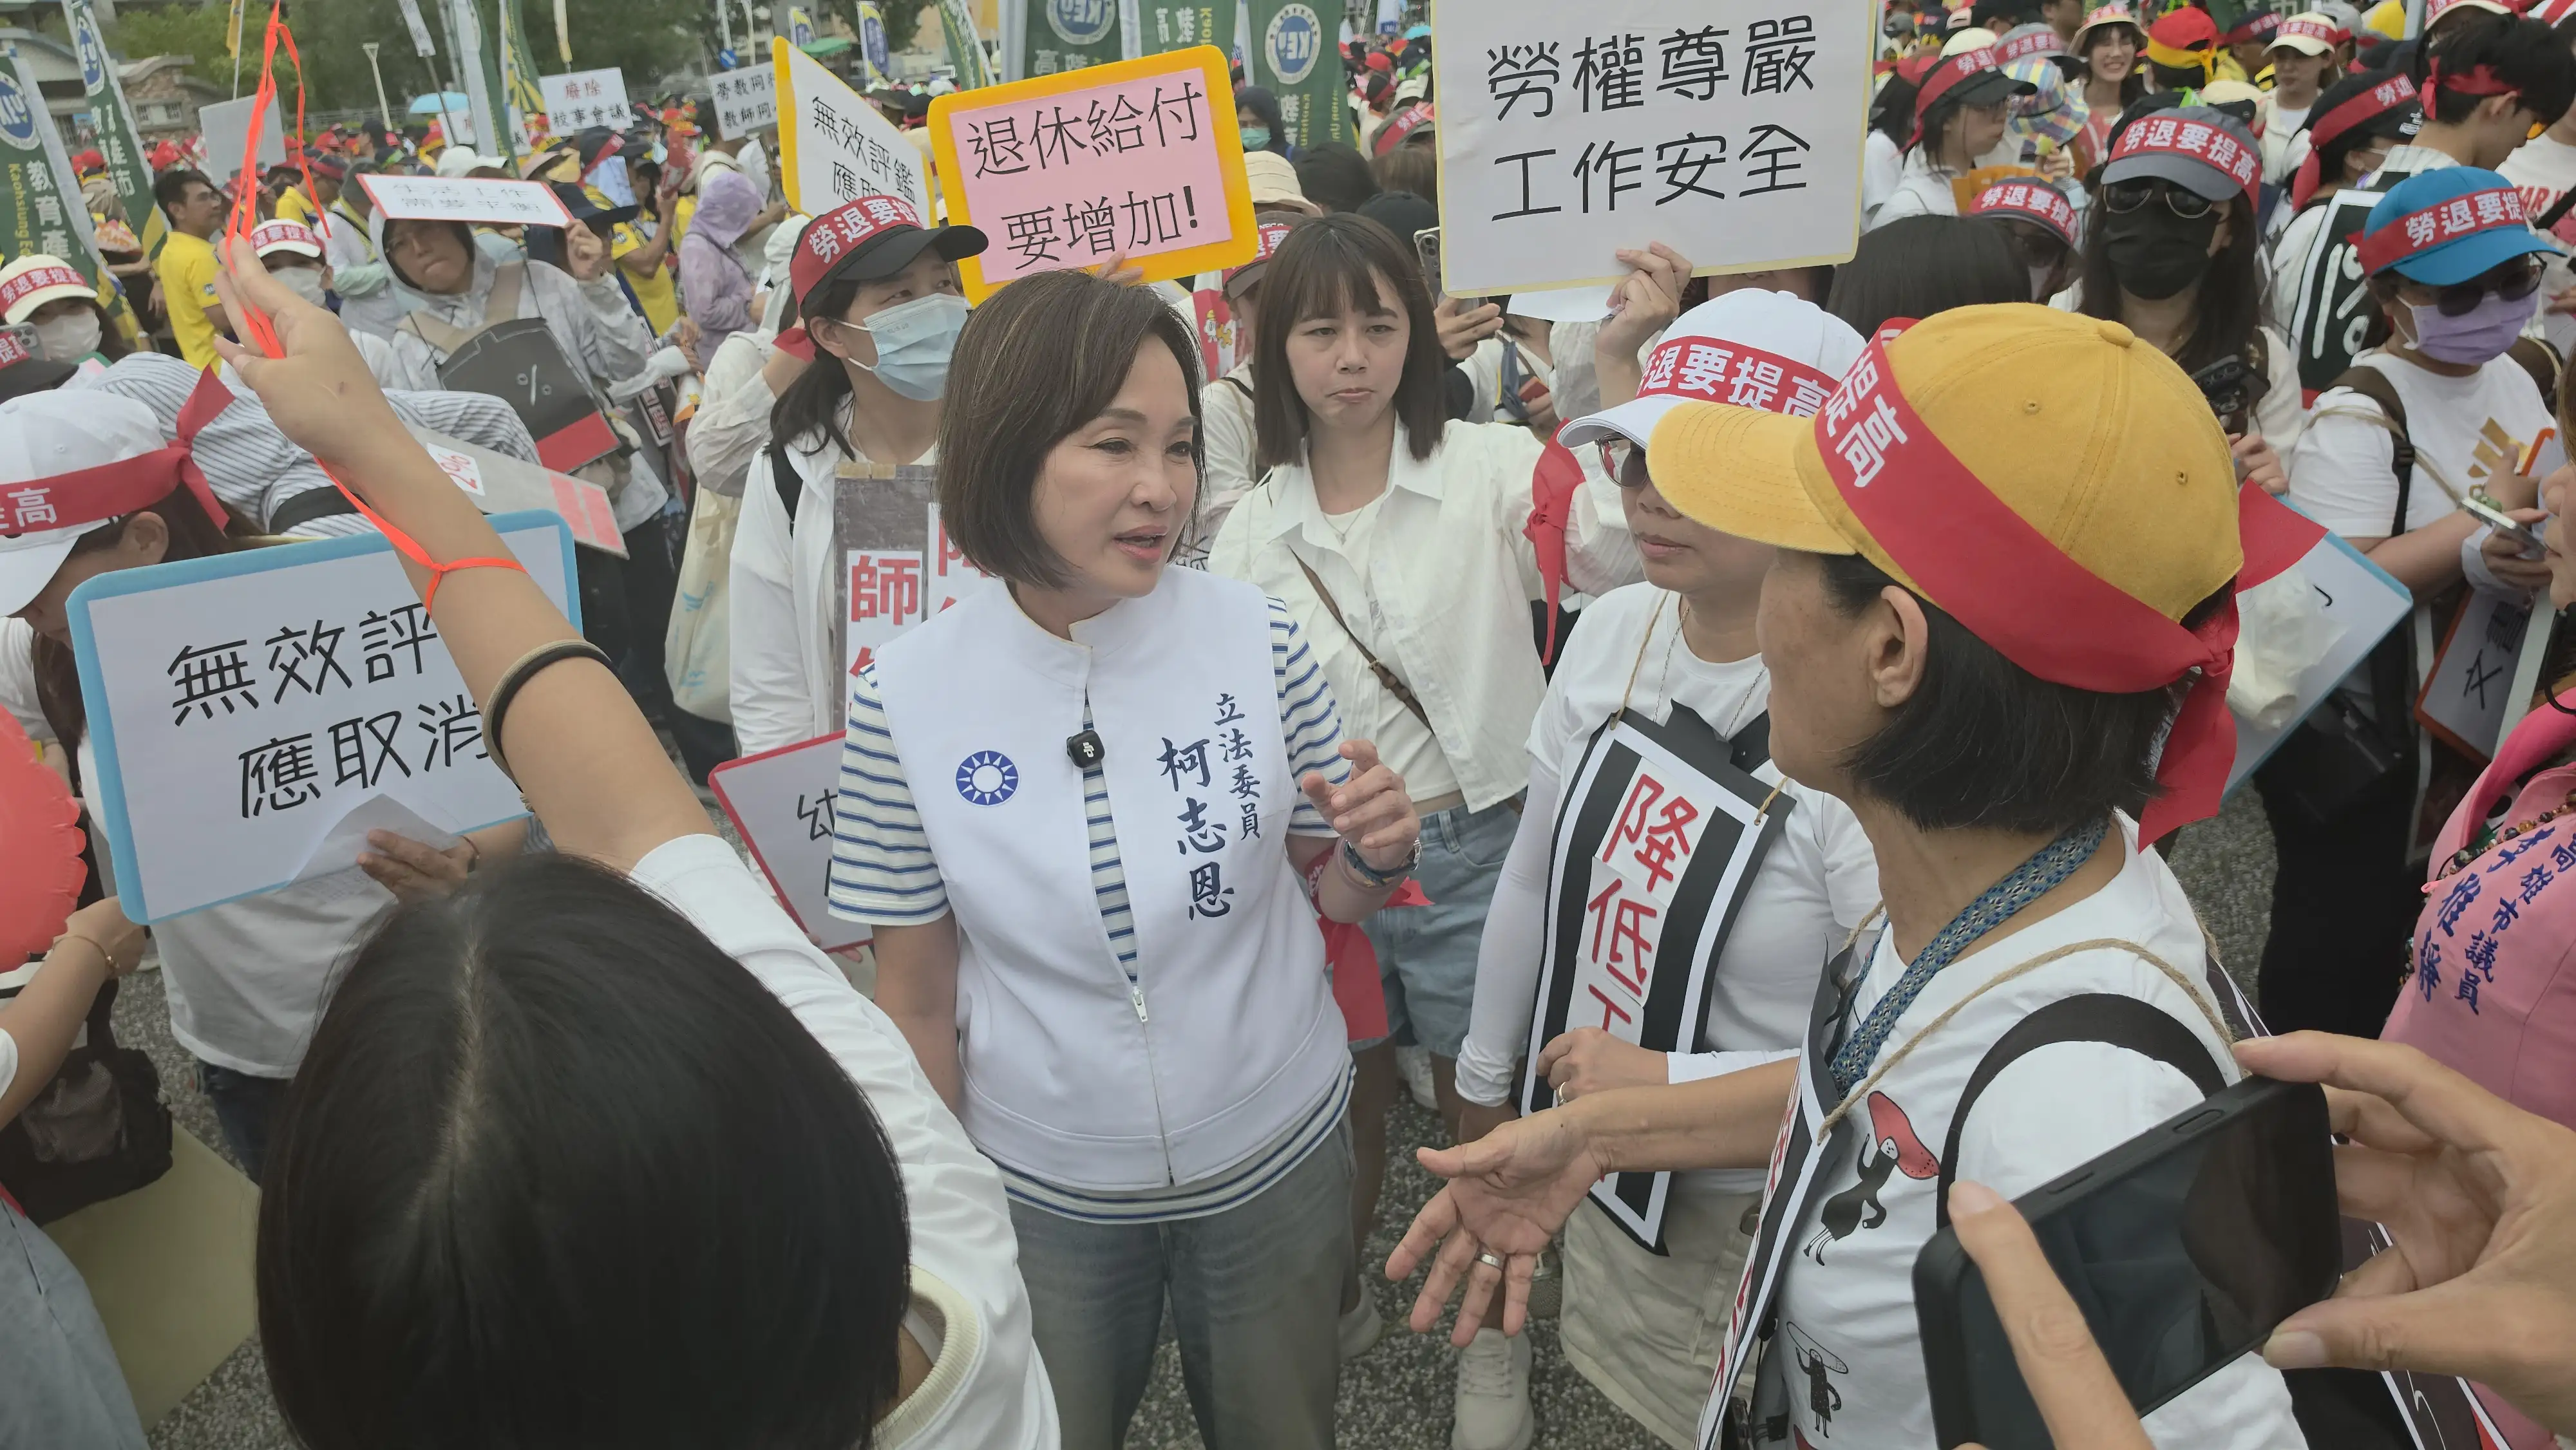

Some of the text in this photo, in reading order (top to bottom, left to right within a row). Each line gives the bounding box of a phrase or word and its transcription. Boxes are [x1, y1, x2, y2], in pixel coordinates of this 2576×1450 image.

[724, 101, 776, 128] 教師同
[1487, 15, 1816, 121] 勞權尊嚴
[812, 96, 916, 205] 無效評鑑
[966, 81, 1203, 179] 退休給付
[1492, 124, 1810, 221] 工作安全
[2123, 119, 2257, 185] 勞退要提高
[8, 164, 29, 238] Kaohsiung
[809, 198, 923, 264] 勞退要提
[1001, 185, 1198, 270] 要增加!
[1825, 329, 1908, 487] 提高
[0, 487, 57, 529] 高
[167, 602, 437, 726] 無效評
[238, 693, 489, 819] 應取消
[1214, 693, 1260, 840] 立法委員
[1157, 737, 1234, 920] 柯志恩
